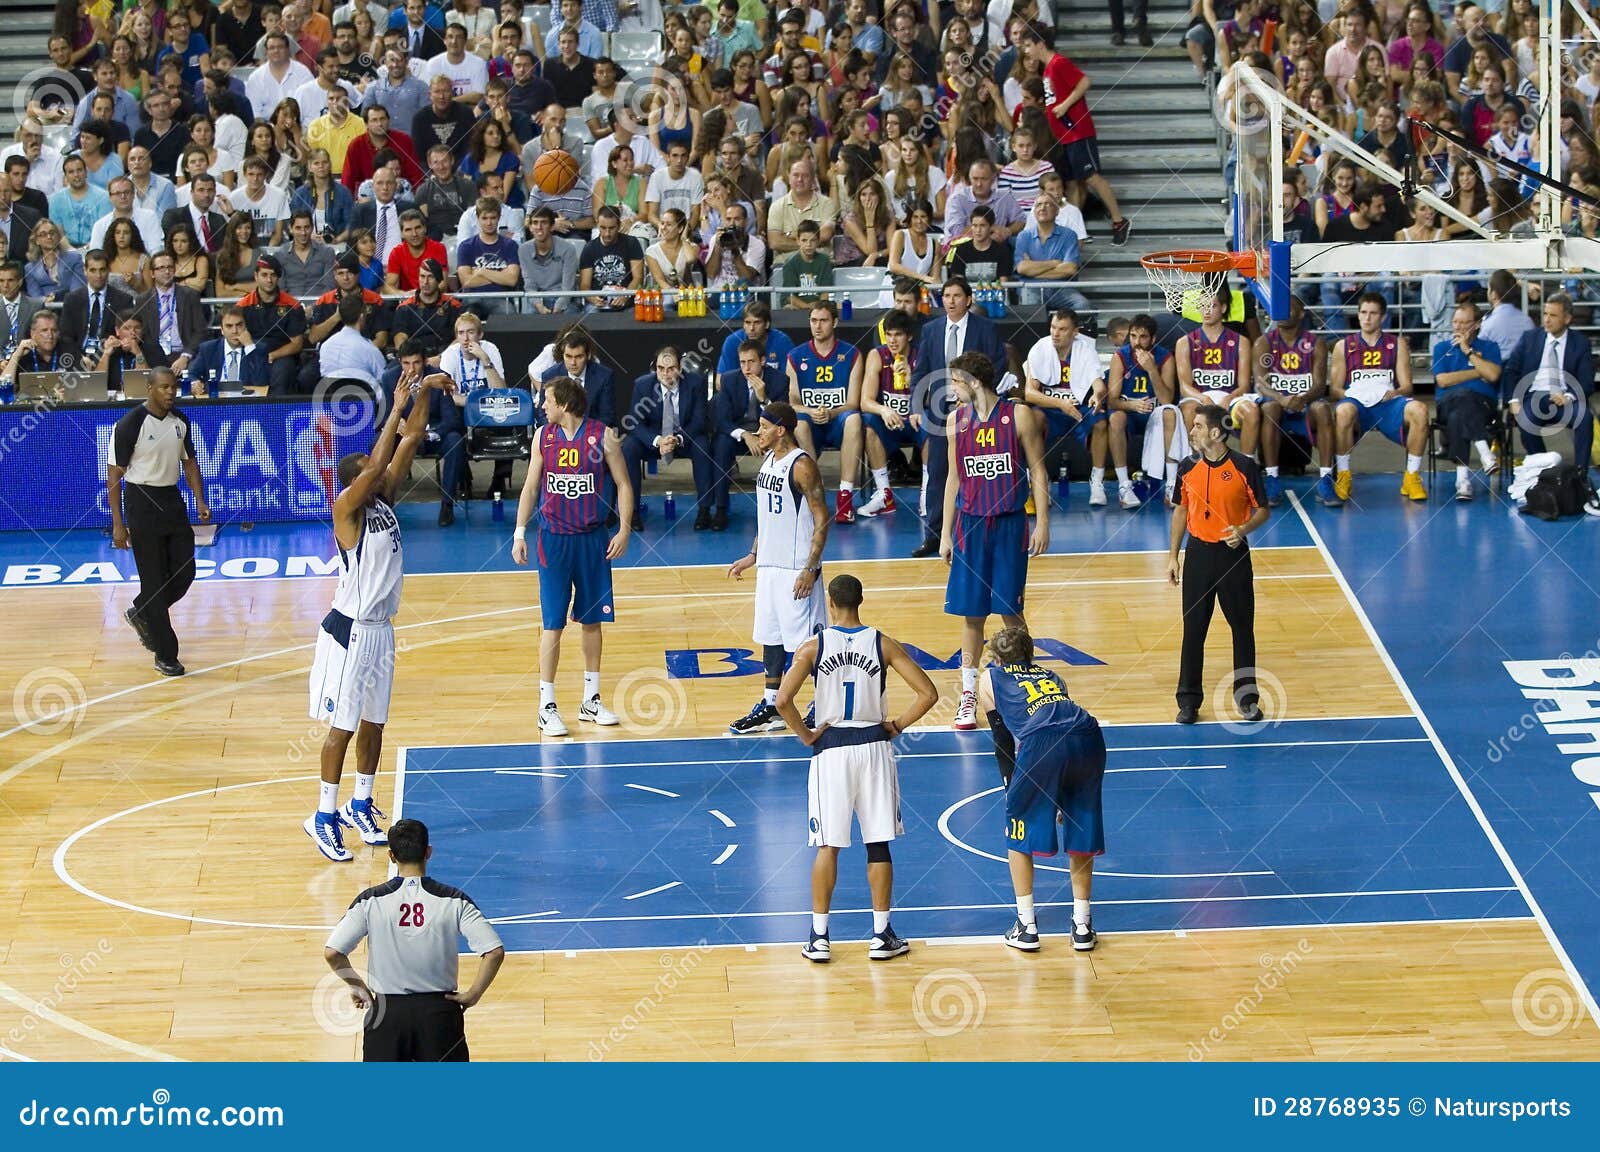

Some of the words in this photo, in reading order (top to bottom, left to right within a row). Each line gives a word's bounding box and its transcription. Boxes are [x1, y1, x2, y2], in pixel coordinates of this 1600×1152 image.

[1204, 349, 1222, 364] 23
[1281, 353, 1299, 369] 33
[1363, 351, 1381, 366] 22
[816, 366, 833, 382] 25
[1133, 376, 1147, 392] 11
[1194, 370, 1233, 387] Regal
[1271, 374, 1312, 391] Regal
[803, 389, 845, 408] Regal
[882, 392, 909, 414] Reg
[976, 428, 996, 448] 44
[559, 448, 579, 467] 20
[965, 454, 1011, 478] Regal
[548, 474, 594, 497] Regal
[758, 472, 785, 493] ALLAS
[208, 483, 282, 511] Bank
[768, 493, 783, 514] 13
[818, 651, 881, 678] CUNNINGHAM
[843, 681, 855, 720] 1
[1011, 819, 1025, 840] 18
[399, 903, 424, 927] 28
